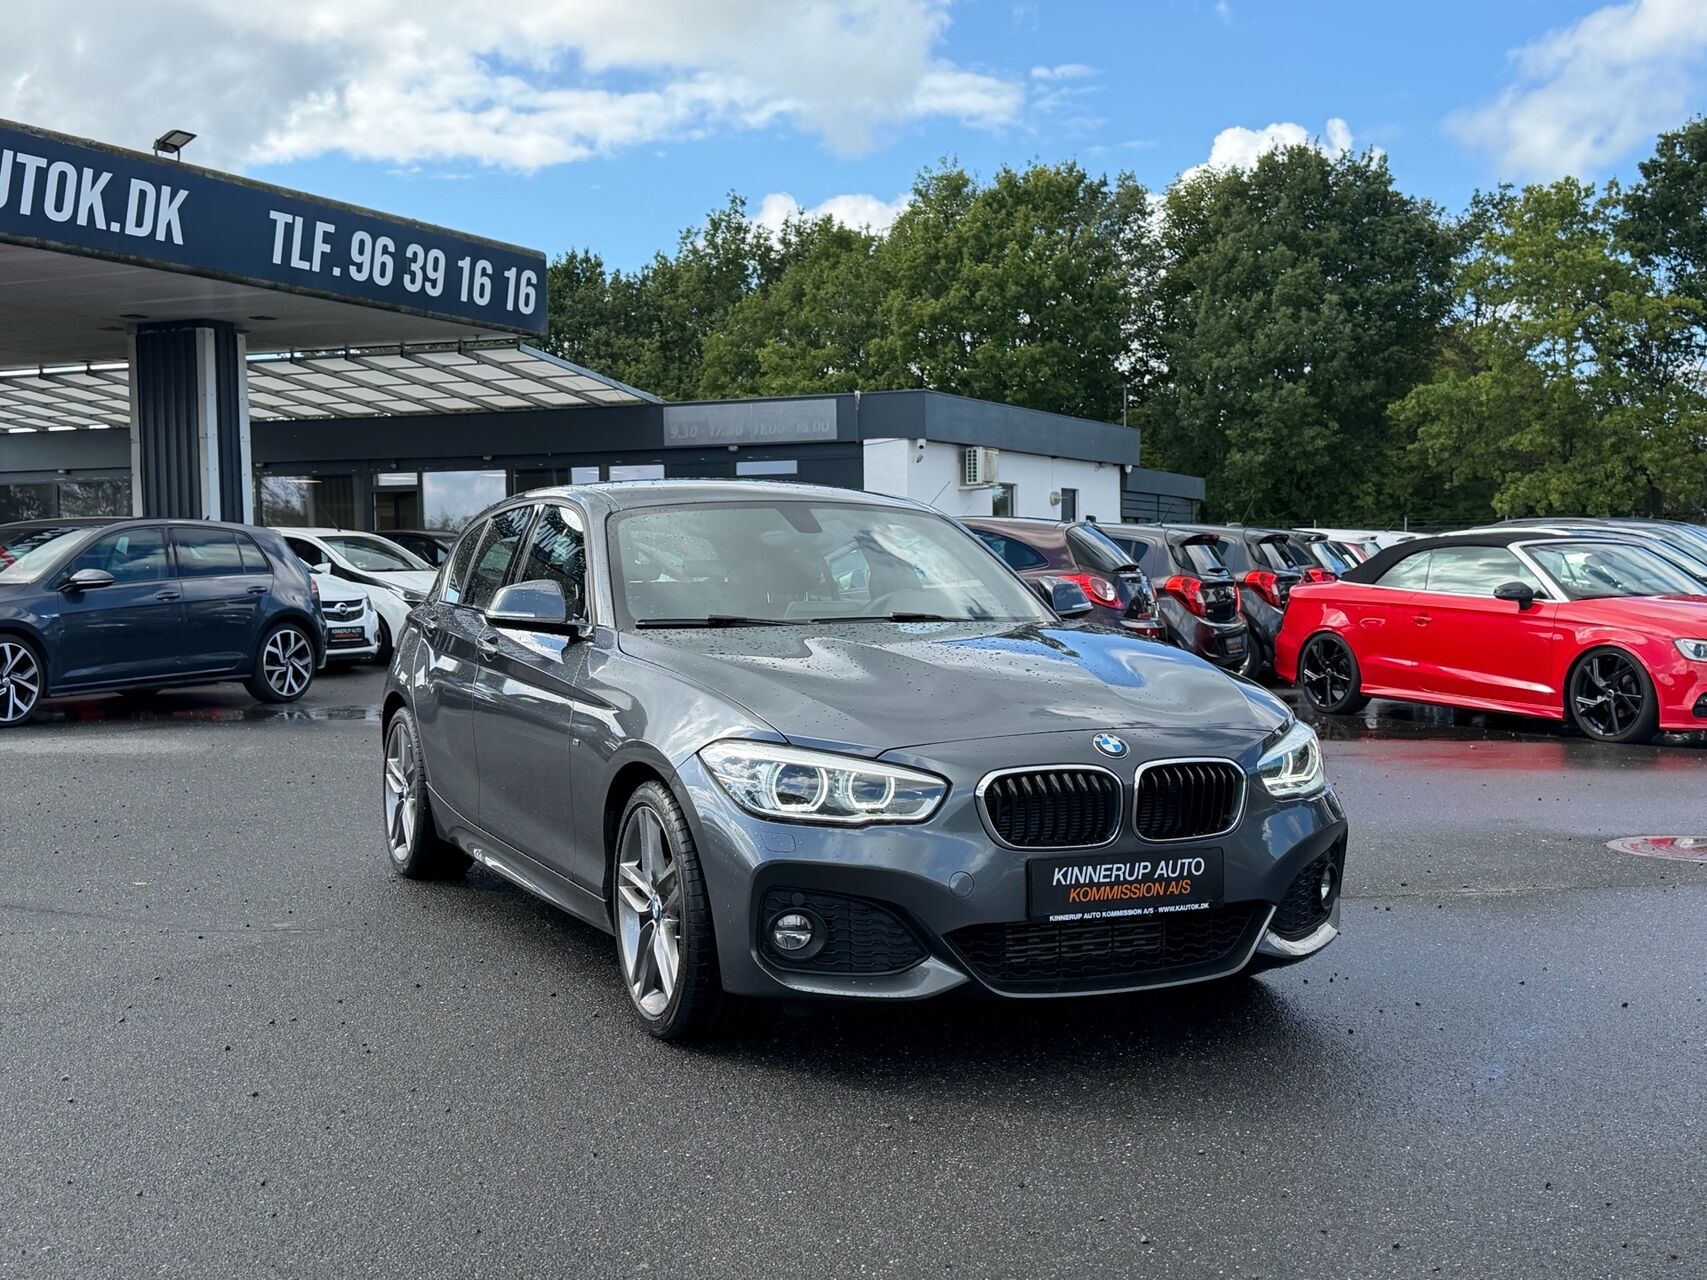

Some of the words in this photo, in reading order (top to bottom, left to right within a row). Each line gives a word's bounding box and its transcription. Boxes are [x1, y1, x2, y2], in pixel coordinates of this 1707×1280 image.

[269, 210, 341, 277] TLF.
[349, 230, 395, 287] 96
[403, 243, 446, 297] 39
[457, 256, 493, 306] 16
[504, 266, 538, 315] 16
[1052, 861, 1151, 886] KINNERUP
[1154, 857, 1205, 879] AUTO
[1069, 881, 1165, 903] KOMMISSION
[1167, 880, 1191, 896] A/S
[1049, 913, 1083, 922] KINNERUP
[1083, 911, 1101, 920] AUTO
[1102, 908, 1142, 918] KOMMISSION
[1143, 907, 1154, 915] A/S
